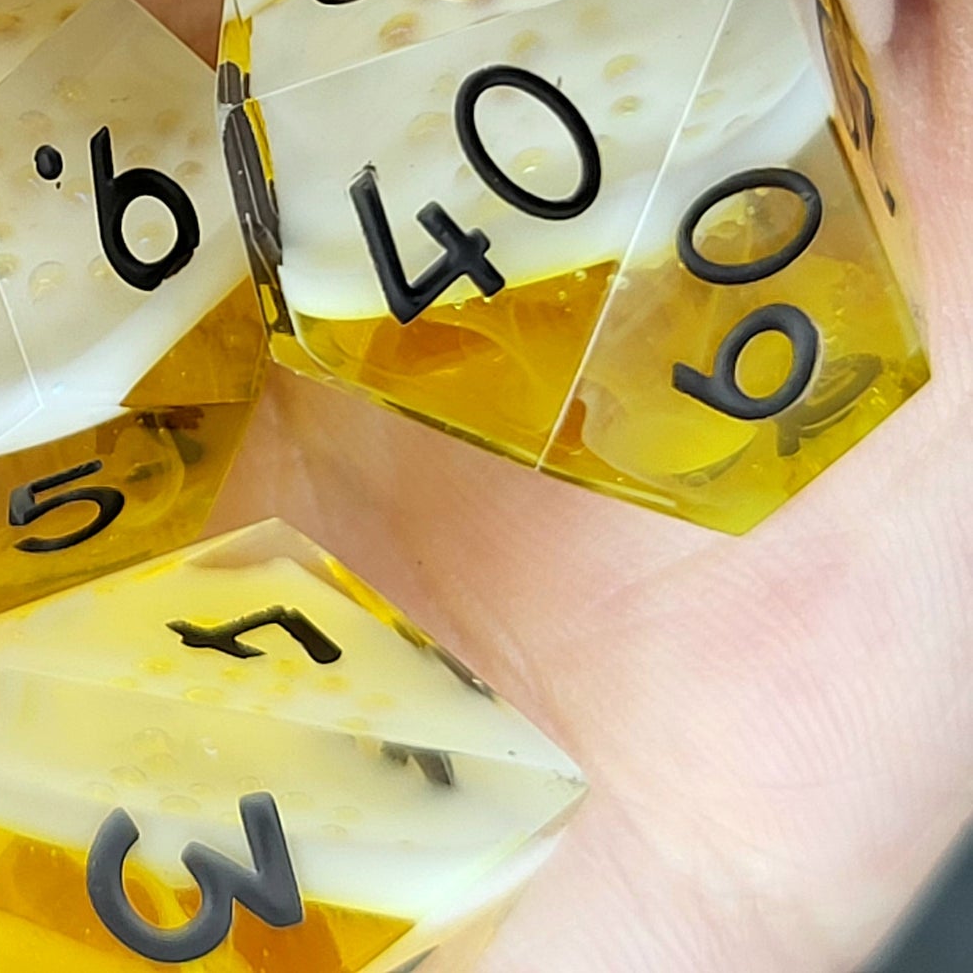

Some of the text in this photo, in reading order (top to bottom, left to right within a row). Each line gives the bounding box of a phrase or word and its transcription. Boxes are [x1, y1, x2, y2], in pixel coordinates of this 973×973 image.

[349, 64, 602, 325] 40
[8, 460, 125, 553] 5
[86, 795, 304, 964] 3
